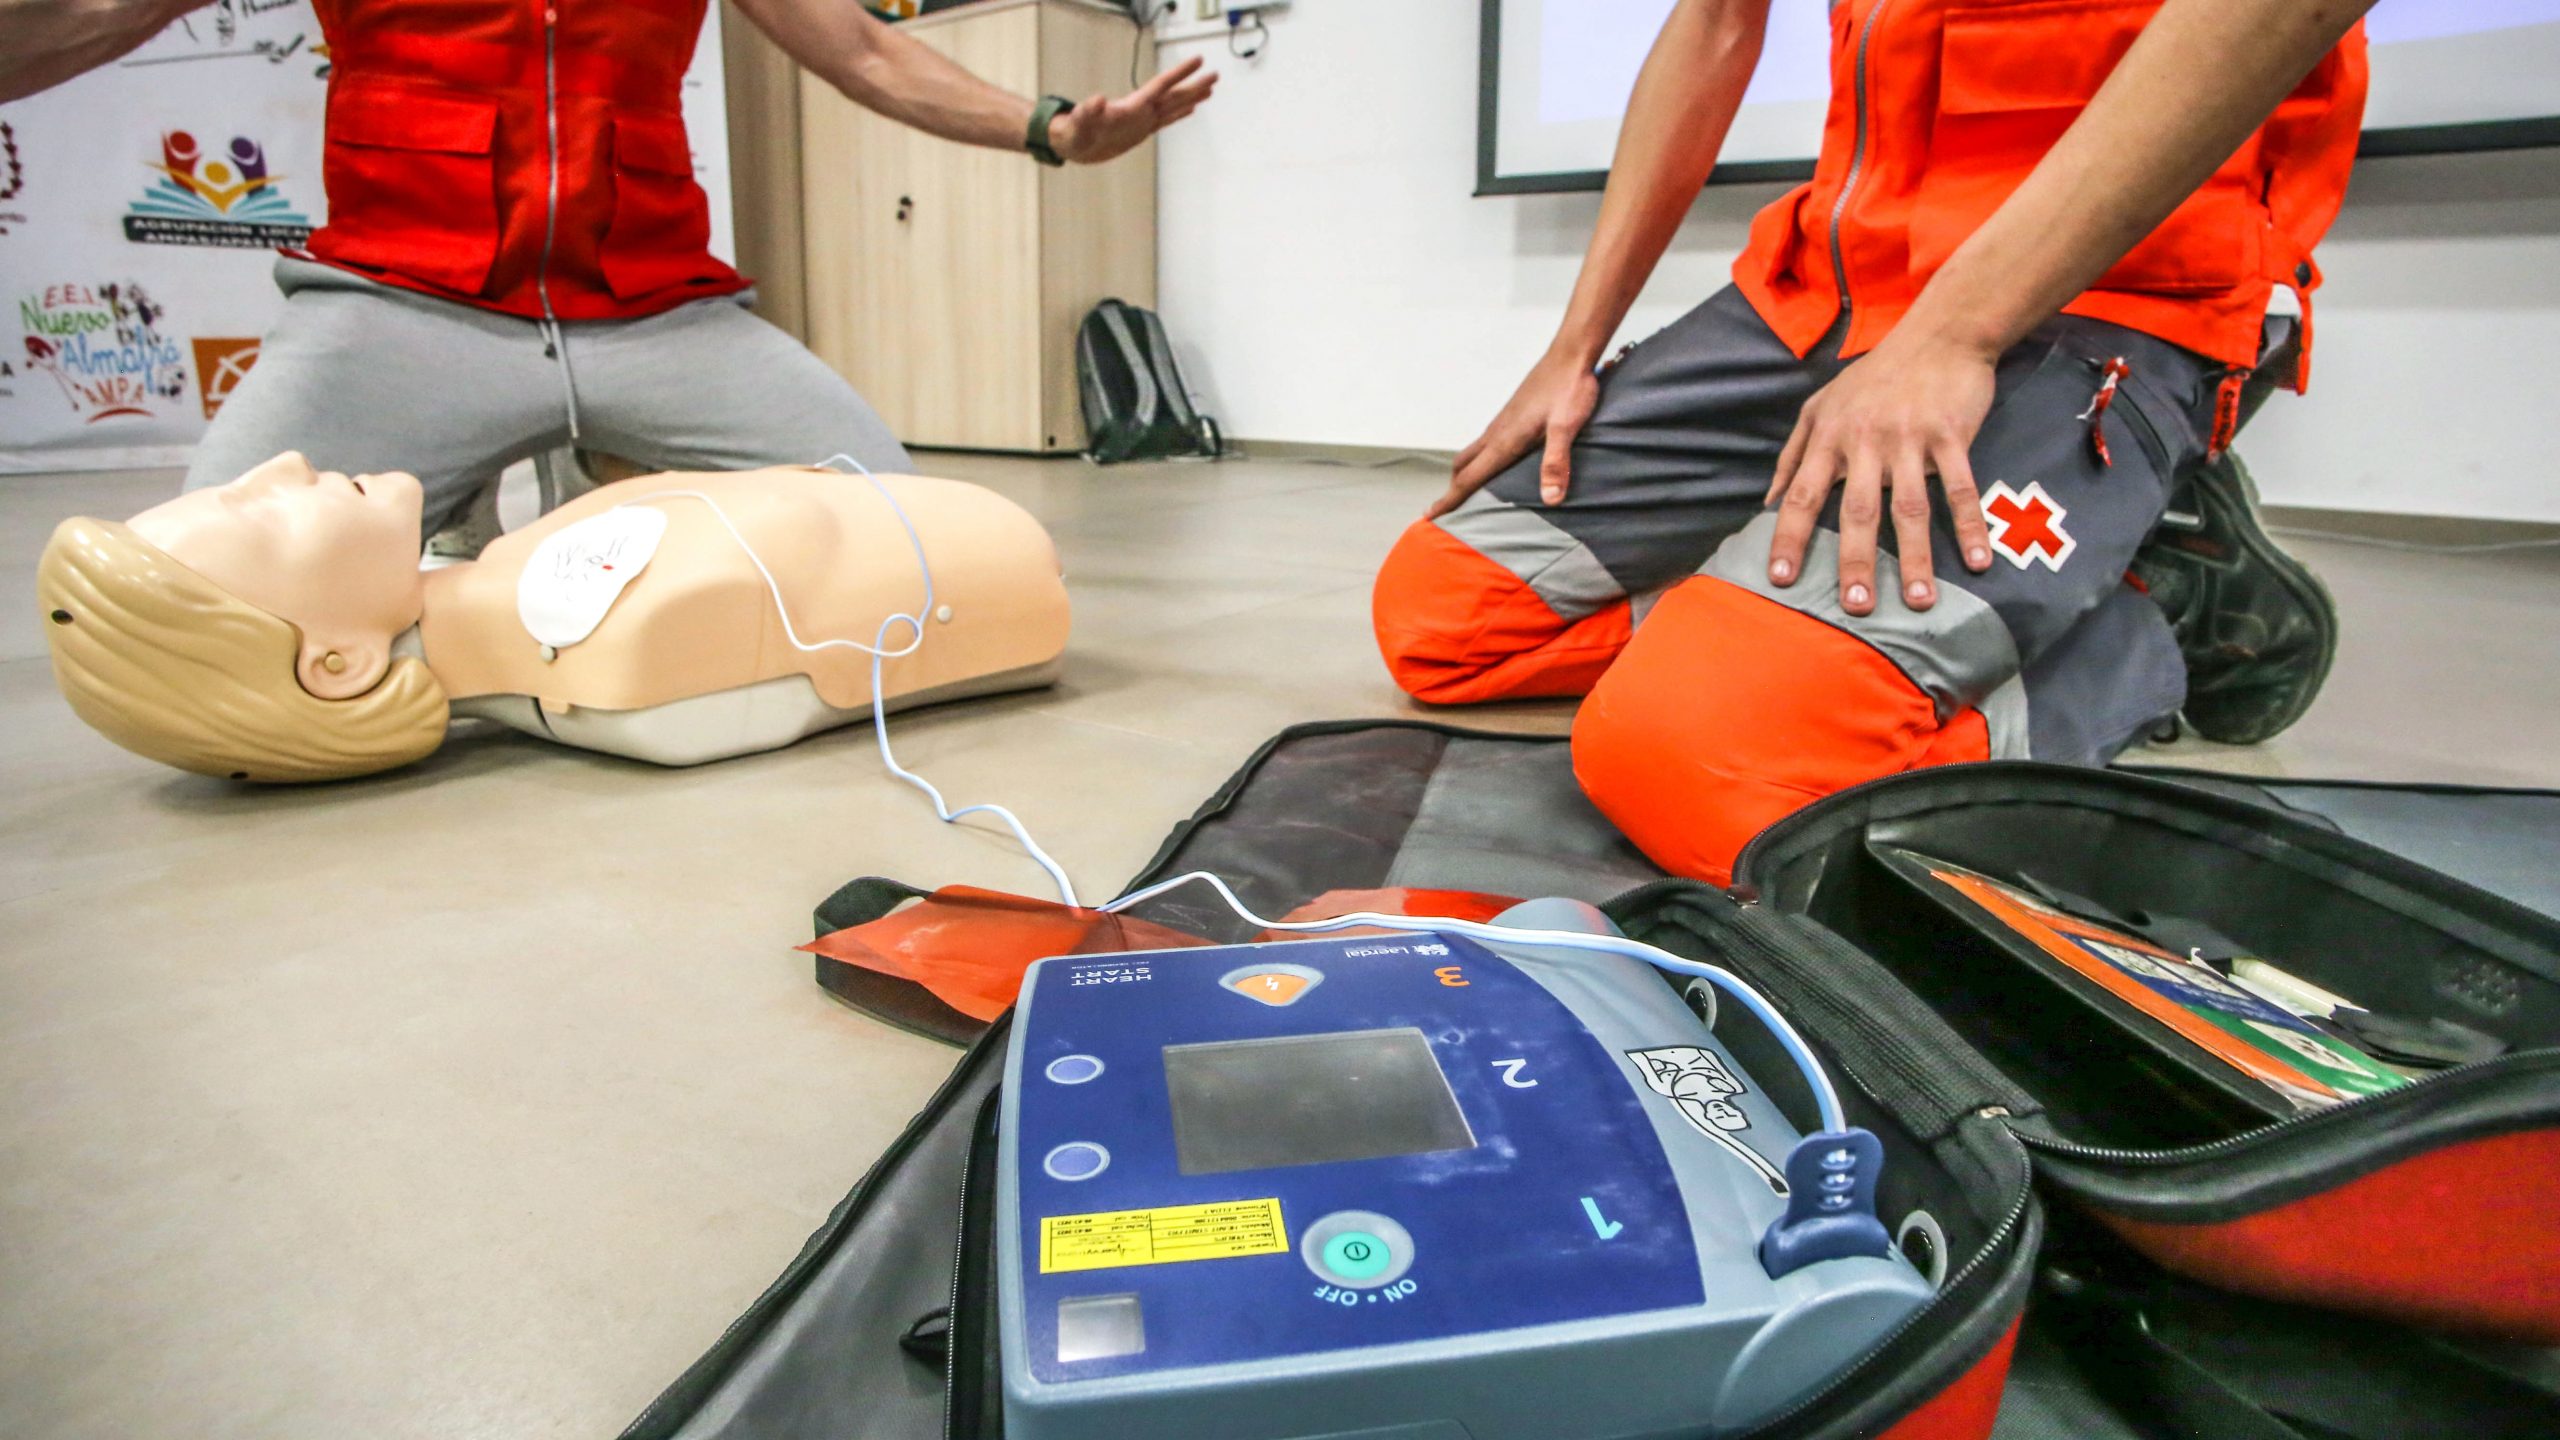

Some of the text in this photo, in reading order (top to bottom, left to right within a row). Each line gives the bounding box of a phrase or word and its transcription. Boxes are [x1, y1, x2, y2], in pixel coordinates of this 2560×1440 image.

[1345, 946, 1410, 958] Laerdal
[1070, 967, 1150, 978] START
[1071, 974, 1152, 986] HEART
[1434, 966, 1471, 988] 3
[1490, 1057, 1540, 1090] 2
[1579, 1197, 1623, 1242] 1
[1314, 1279, 1418, 1306] ON OFF
